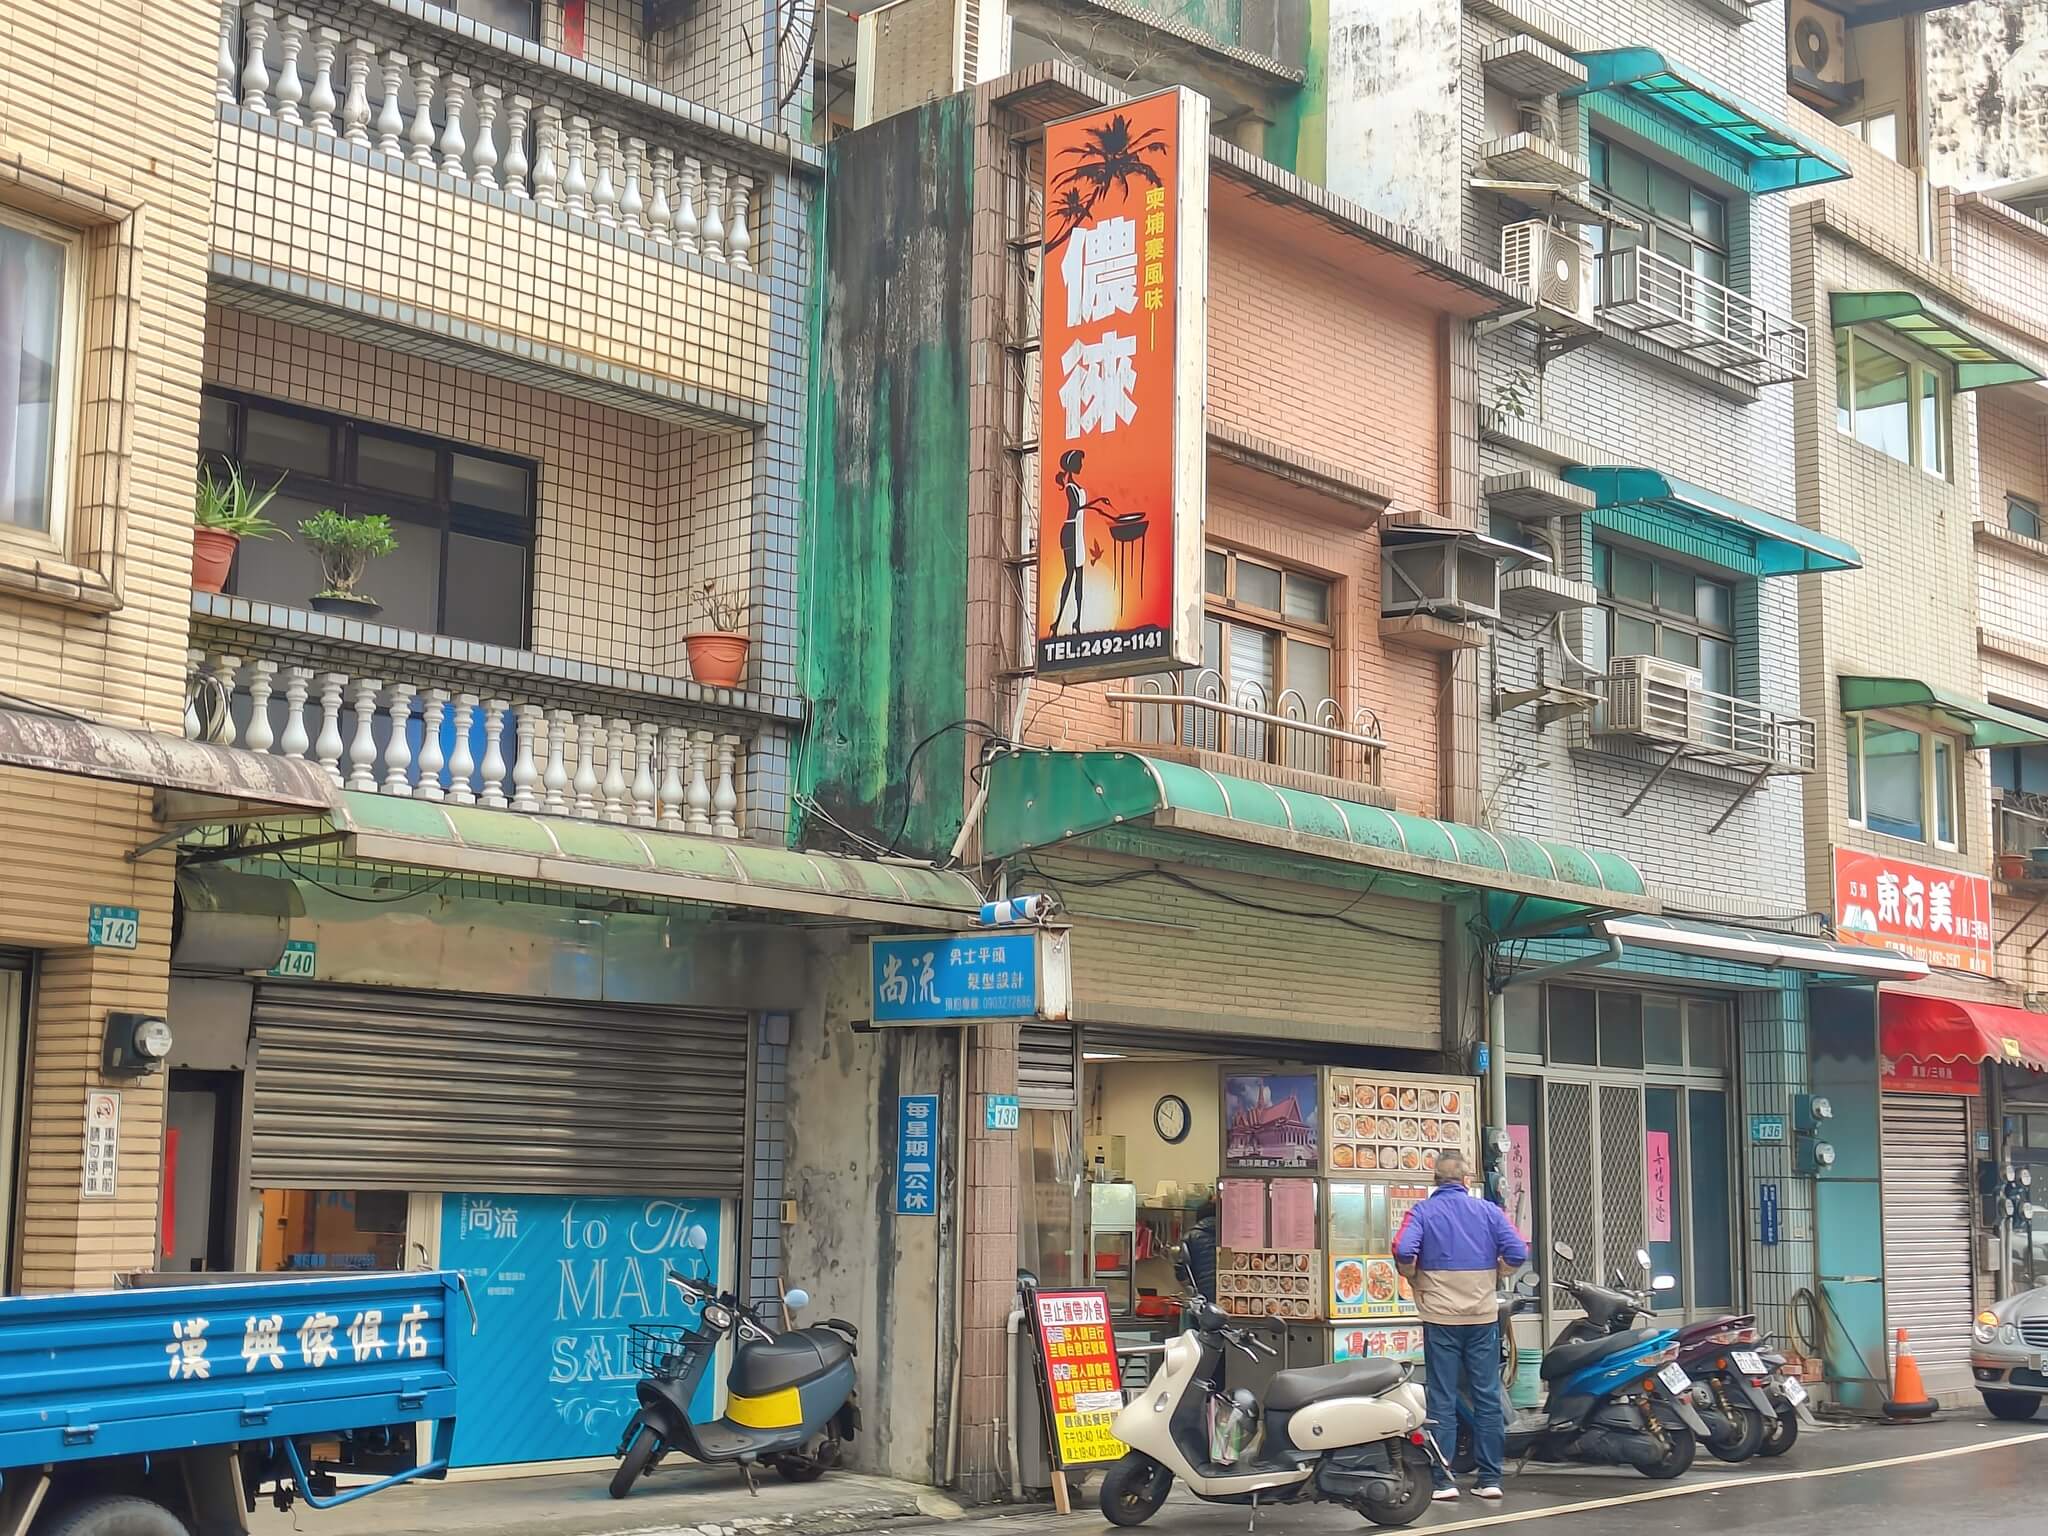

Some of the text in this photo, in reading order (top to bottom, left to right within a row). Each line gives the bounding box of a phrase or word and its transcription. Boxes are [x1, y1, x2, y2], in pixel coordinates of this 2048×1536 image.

[1144, 186, 1165, 311] 柬埔寨風味
[1059, 215, 1139, 440] 儂徠
[1876, 869, 1953, 934] 東方美
[105, 921, 135, 944] 142
[284, 953, 312, 973] 140
[879, 951, 942, 1005] 尚流
[950, 946, 1006, 966] 男士平頭
[968, 971, 1025, 991] 髮型設計
[997, 1108, 1017, 1125] 138
[904, 1102, 931, 1209] 每星期一公休
[469, 1200, 518, 1239] 尚流
[561, 1200, 608, 1249] to
[1043, 1300, 1105, 1323] 禁止攜帶外食
[165, 1304, 430, 1380] 漢興傢俱店
